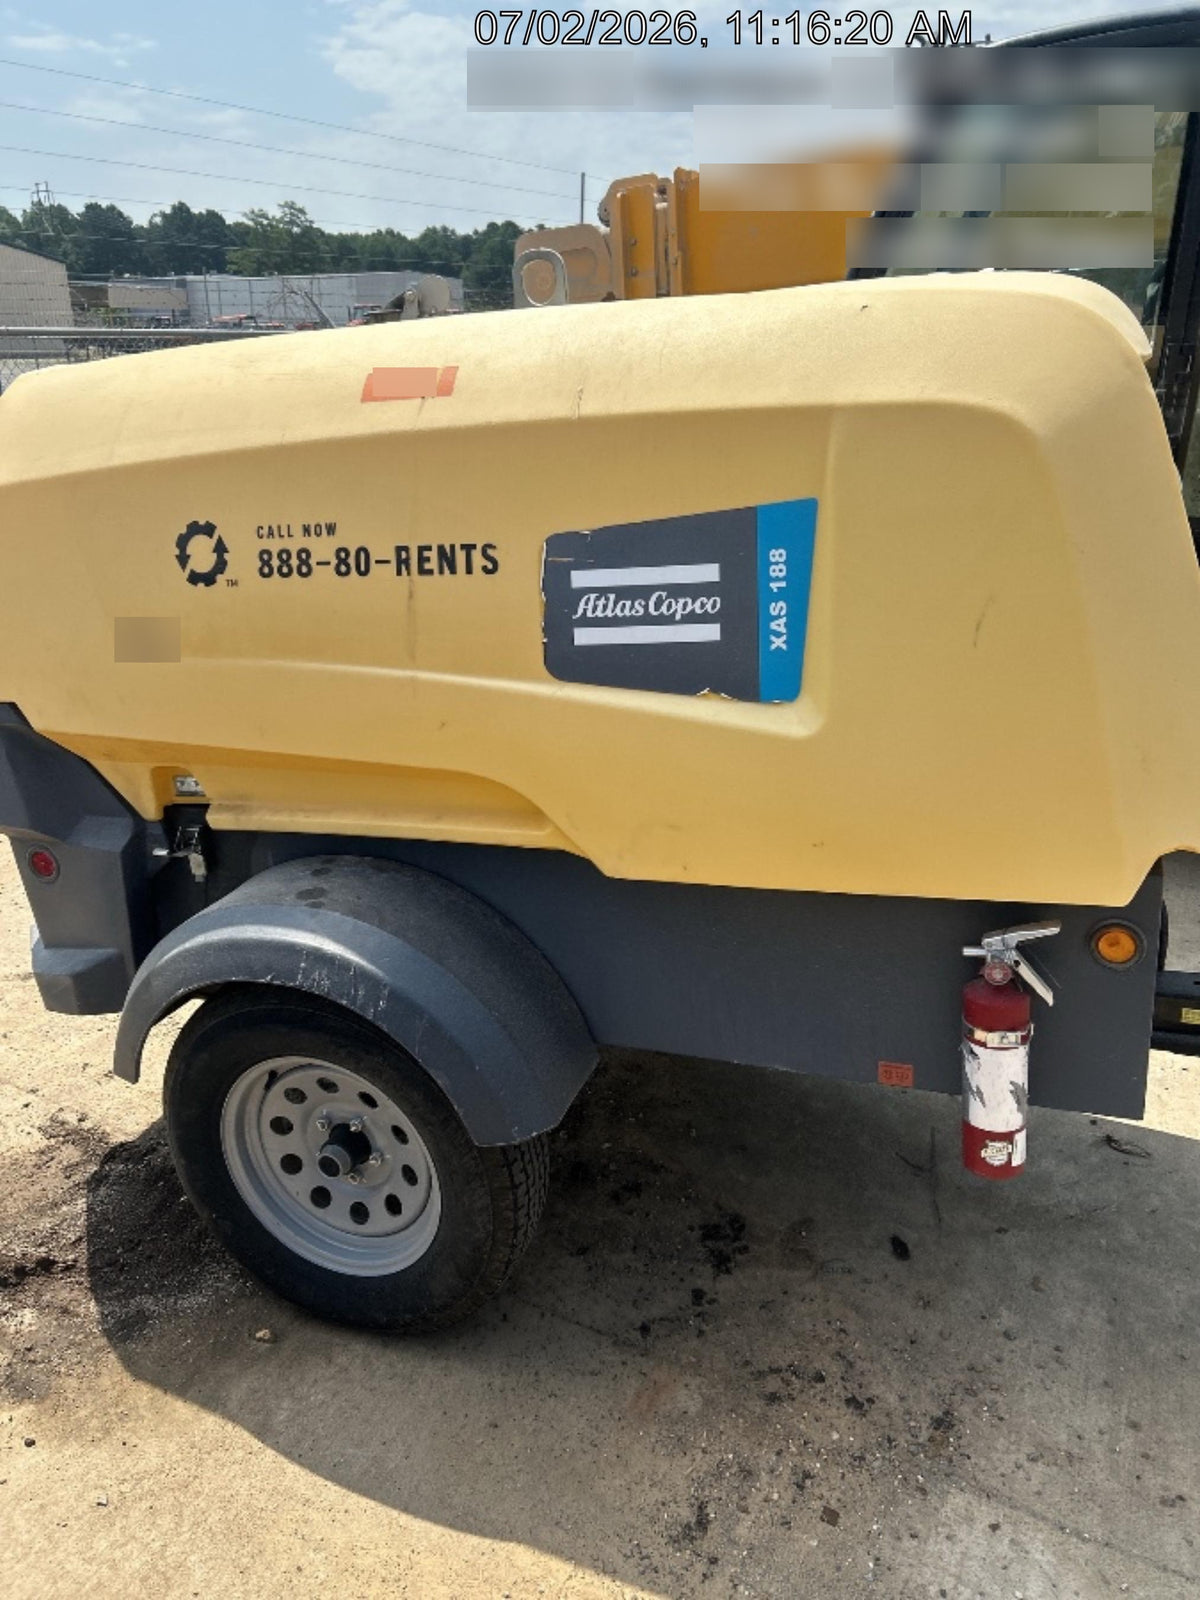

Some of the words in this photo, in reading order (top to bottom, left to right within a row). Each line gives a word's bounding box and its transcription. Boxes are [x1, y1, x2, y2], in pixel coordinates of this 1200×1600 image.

[256, 524, 294, 539] CALL
[302, 522, 337, 538] NOW
[257, 543, 499, 579] 888-80-RENTS
[768, 548, 787, 592] 188
[226, 579, 239, 588] TM
[572, 593, 646, 619] Atlas
[648, 592, 721, 620] Copco
[769, 600, 788, 651] XAS
